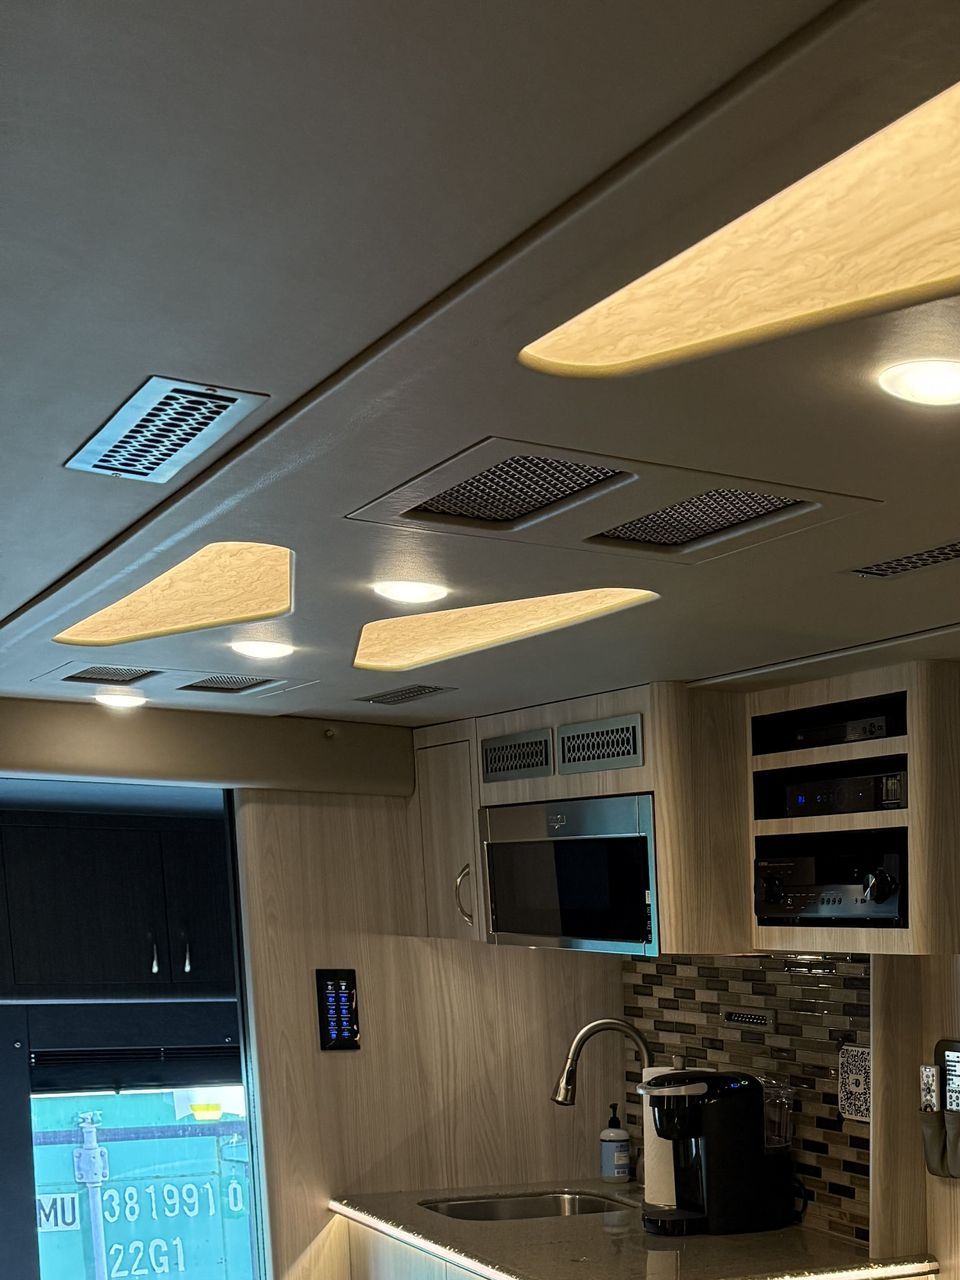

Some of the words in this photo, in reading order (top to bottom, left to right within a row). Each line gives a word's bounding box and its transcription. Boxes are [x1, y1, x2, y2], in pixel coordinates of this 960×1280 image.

[102, 1181, 216, 1223] 381991
[227, 1182, 243, 1212] 0
[109, 1236, 185, 1279] 22G1
